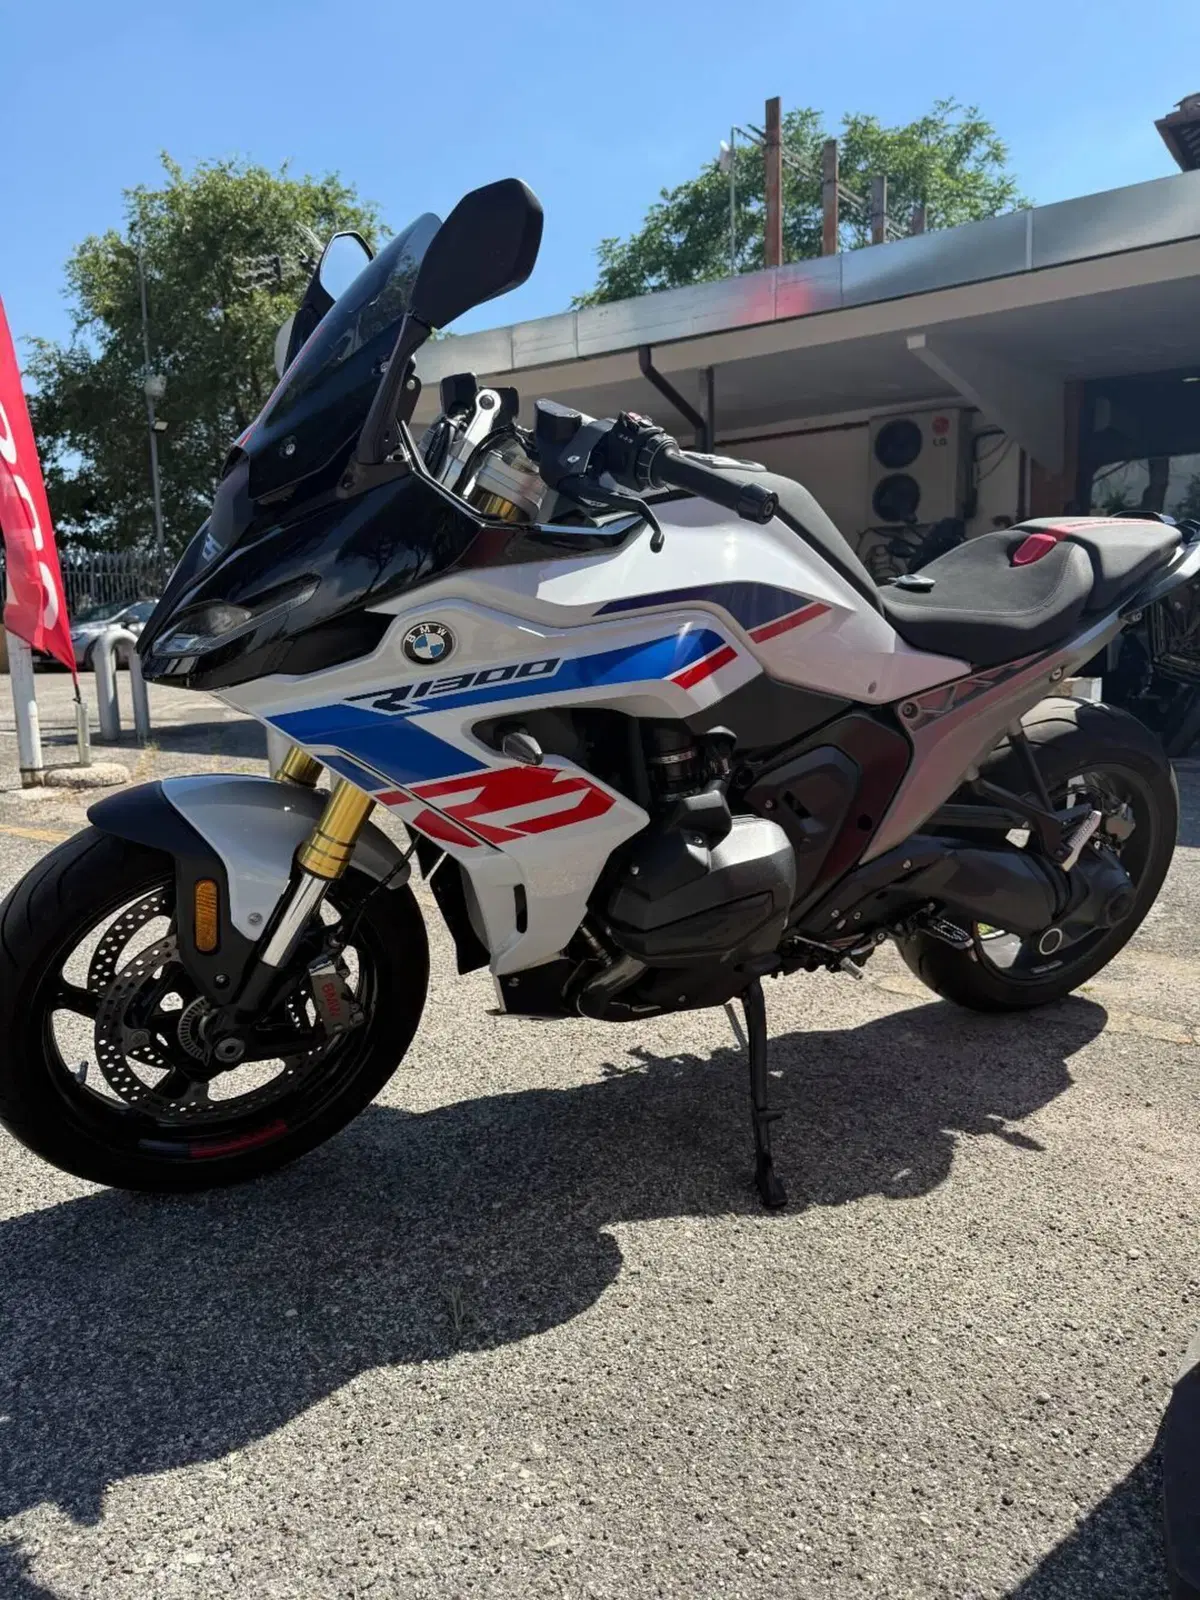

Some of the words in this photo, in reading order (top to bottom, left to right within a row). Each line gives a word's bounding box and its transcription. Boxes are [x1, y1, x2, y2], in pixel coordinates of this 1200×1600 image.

[932, 437, 948, 447] LG
[407, 624, 447, 643] BMW
[344, 657, 562, 712] R1300
[322, 982, 341, 1017] BMW
